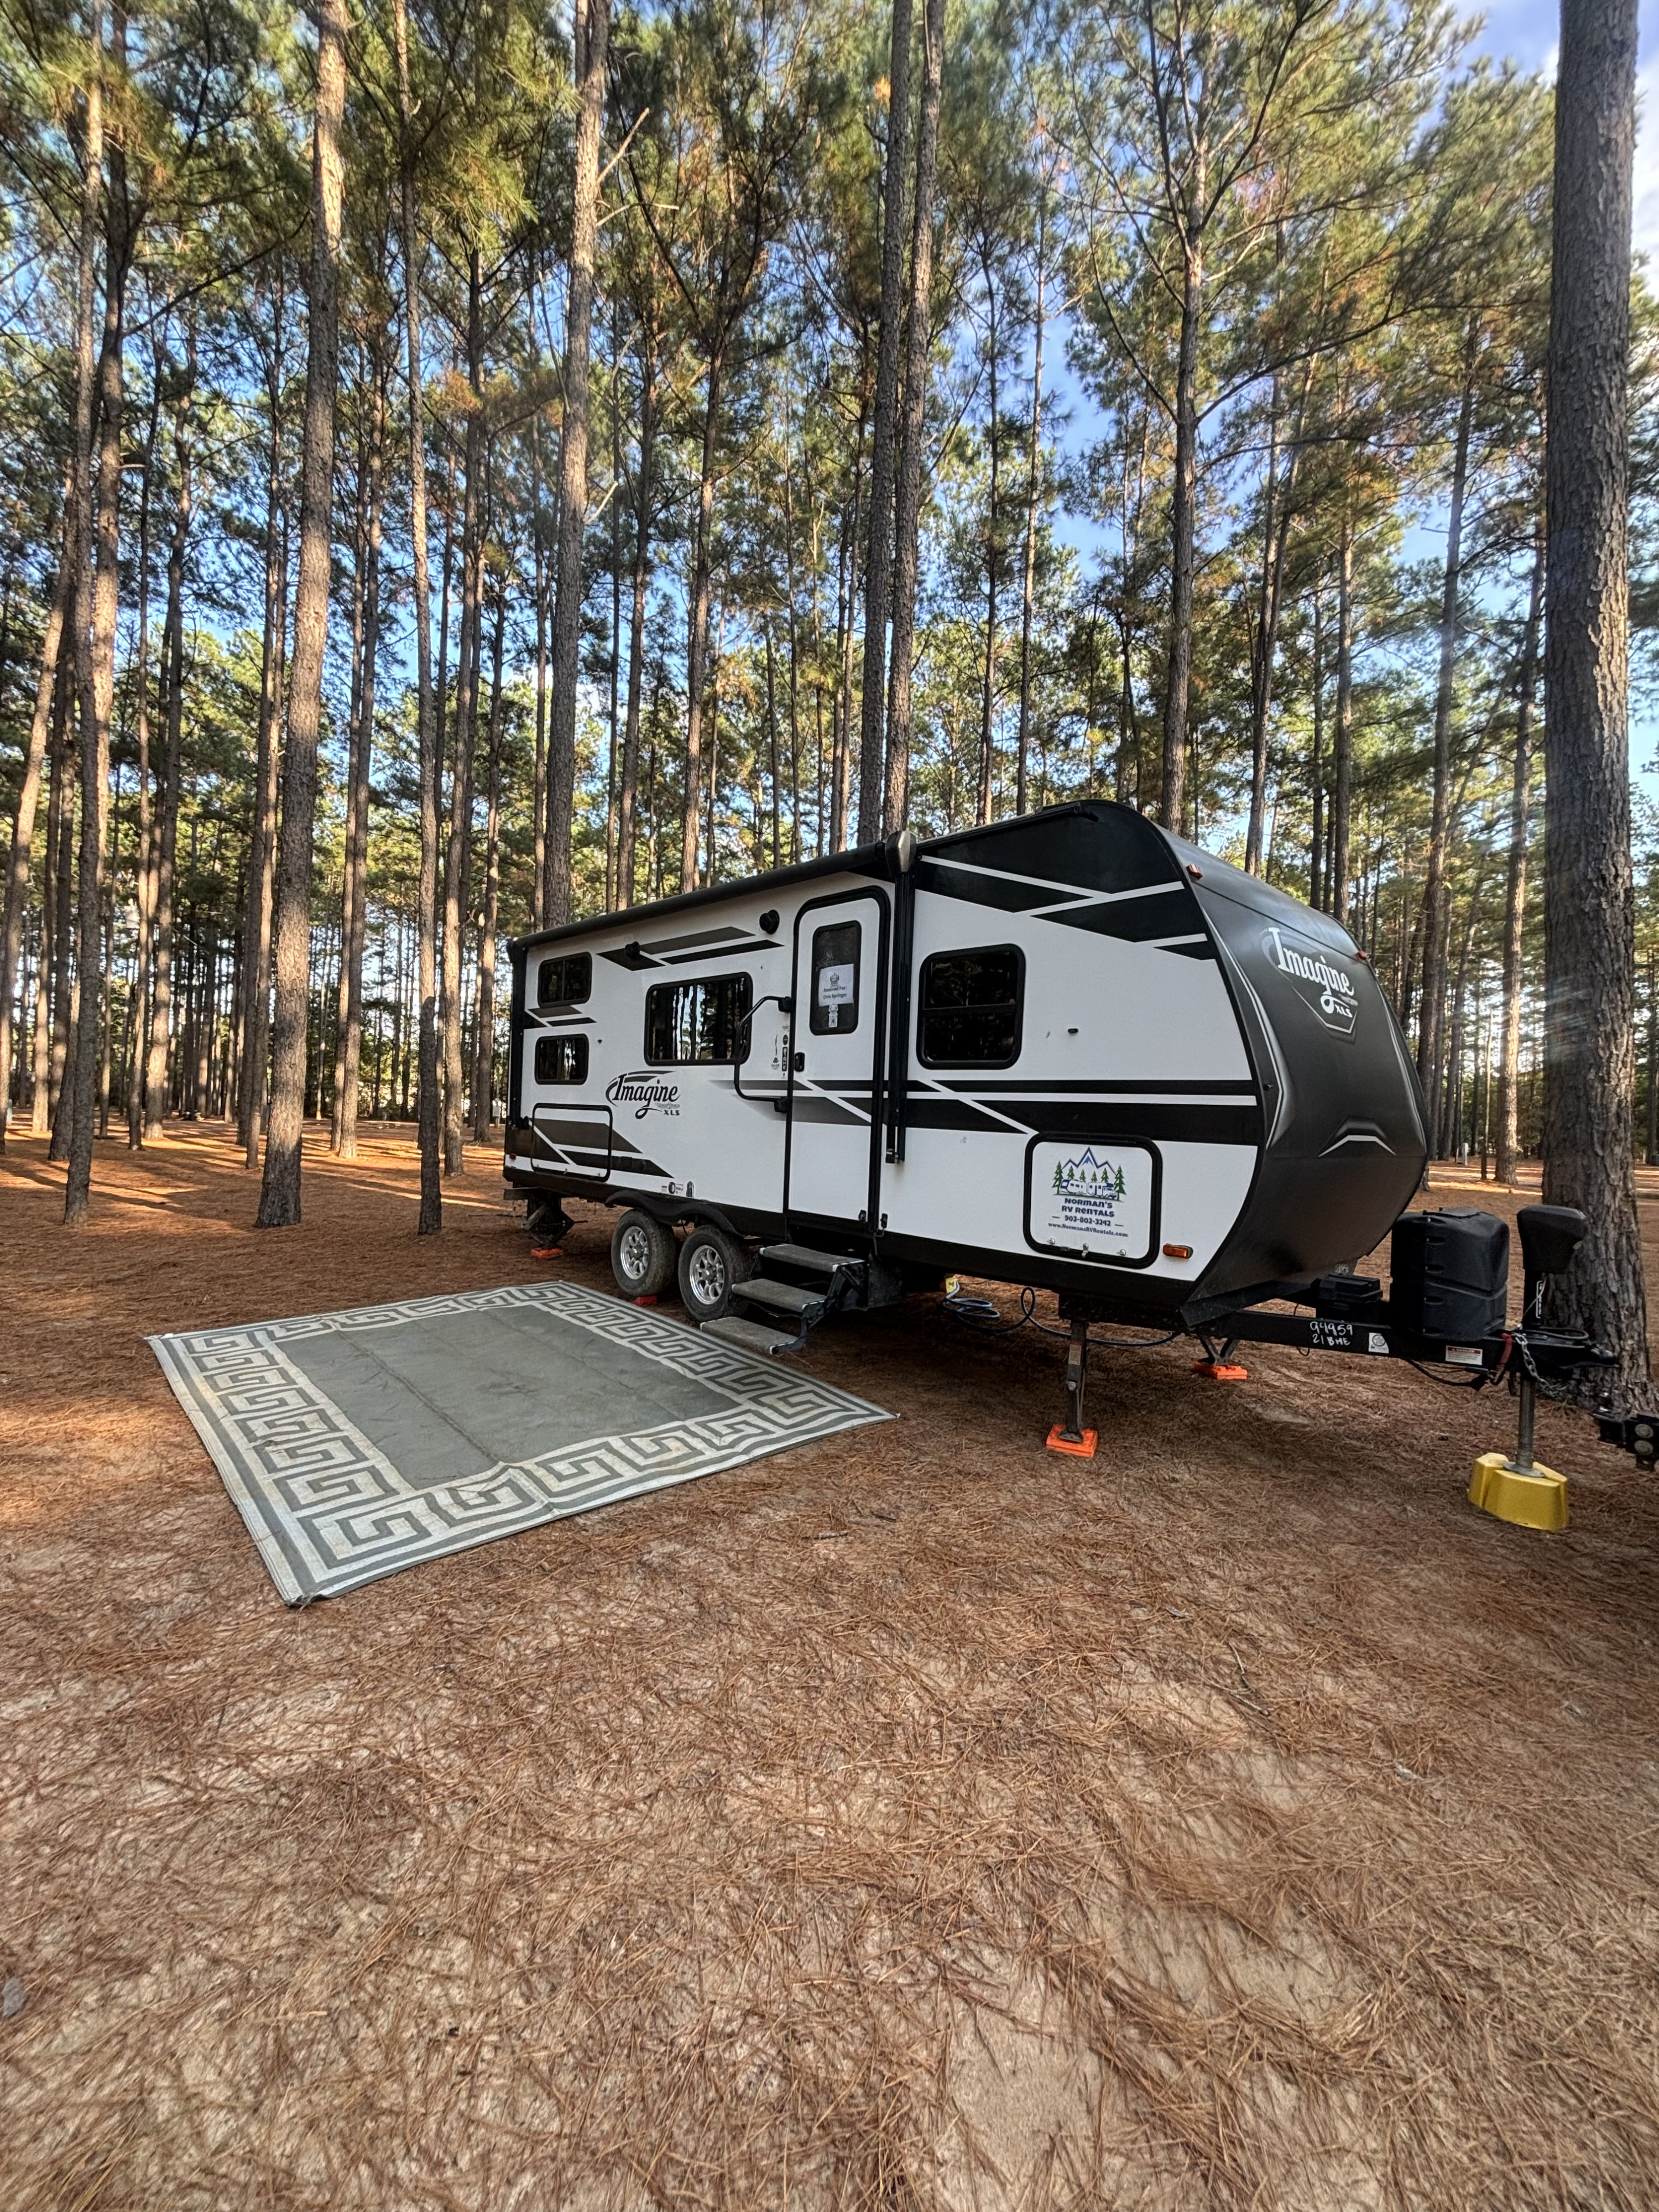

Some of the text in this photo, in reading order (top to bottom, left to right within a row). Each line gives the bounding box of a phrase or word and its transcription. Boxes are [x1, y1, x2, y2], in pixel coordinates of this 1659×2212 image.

[1268, 927, 1354, 1014] Imagine
[1334, 1004, 1353, 1018] XLS
[612, 1073, 681, 1119] Imagine
[1065, 1198, 1113, 1208] NORMAN'S
[1075, 1207, 1115, 1218] RENTALS
[1065, 1215, 1112, 1227] 903-802-3242
[1310, 1321, 1353, 1336] 94959
